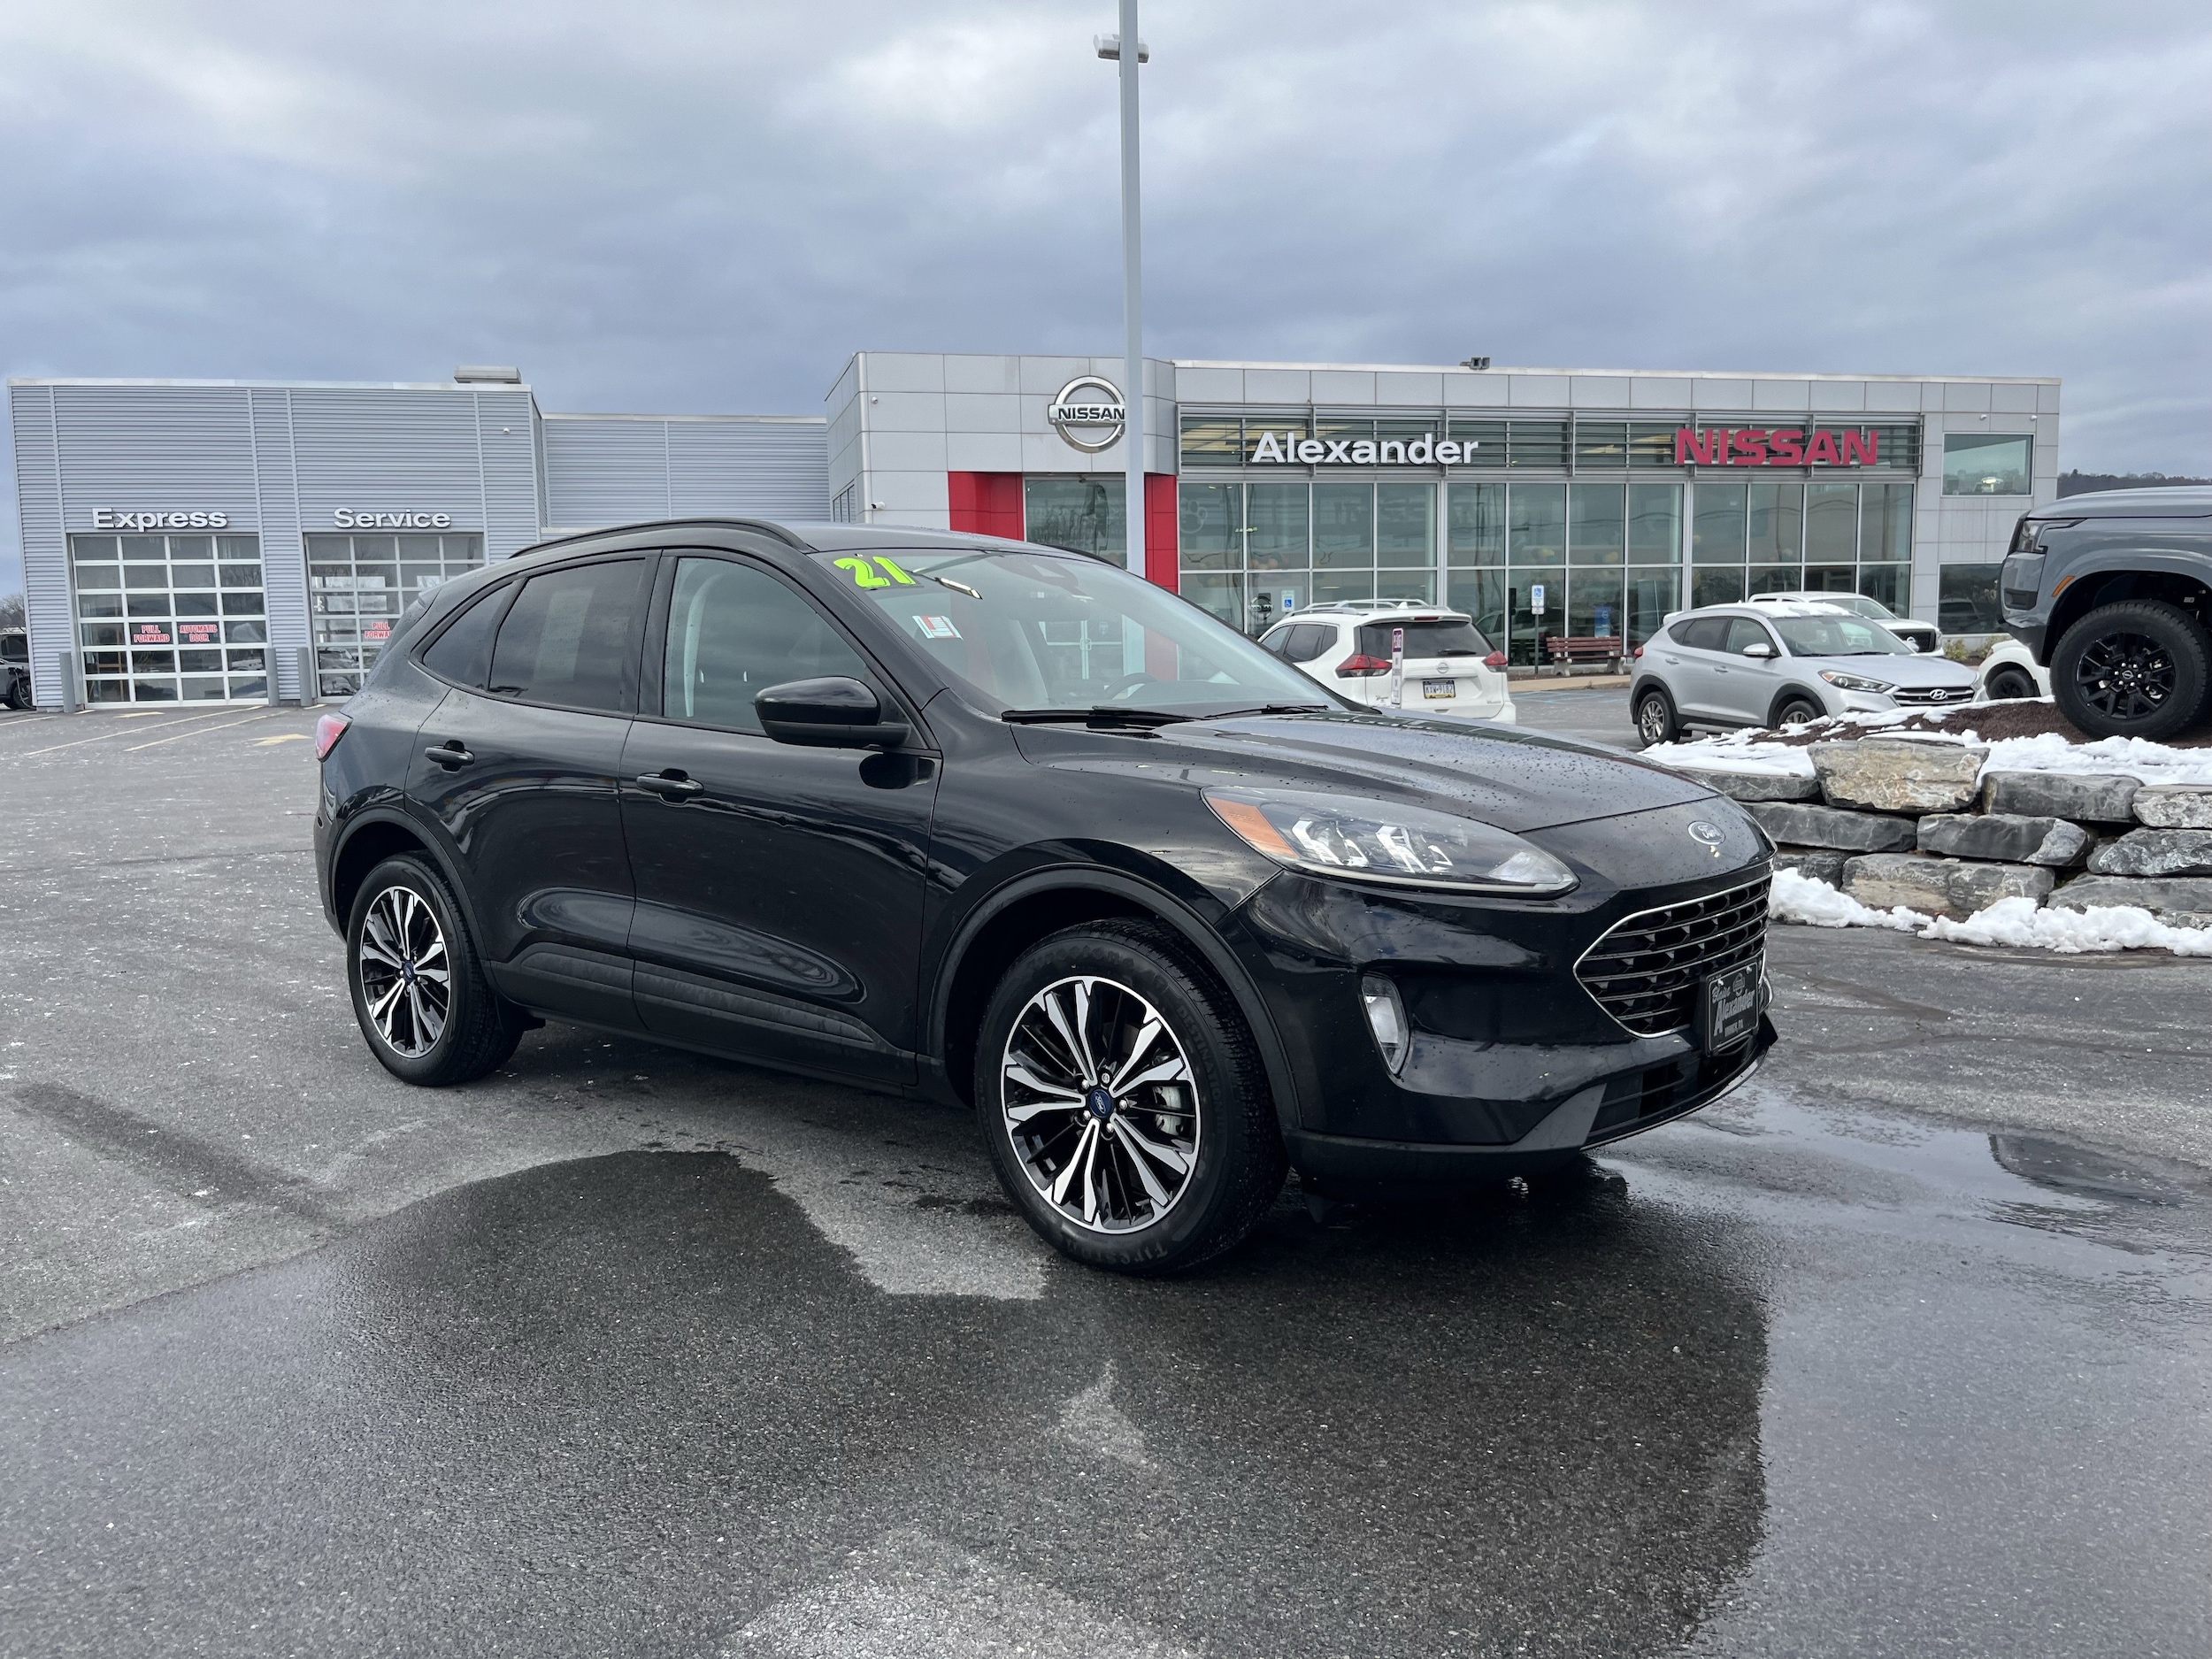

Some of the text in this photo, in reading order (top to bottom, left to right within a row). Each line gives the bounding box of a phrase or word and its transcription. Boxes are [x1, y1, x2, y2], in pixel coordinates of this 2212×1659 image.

[1058, 407, 1125, 420] NISSAN
[1251, 432, 1479, 465] Alexander
[1675, 429, 1878, 465] NISSAN
[92, 507, 228, 533] Express
[334, 507, 451, 528] Service
[833, 556, 917, 588] 21
[142, 625, 161, 634] PULL
[180, 624, 218, 634] AUTOMATIC
[372, 621, 390, 630] PULL
[134, 634, 170, 642] FORWARD
[189, 634, 210, 642] DOOR
